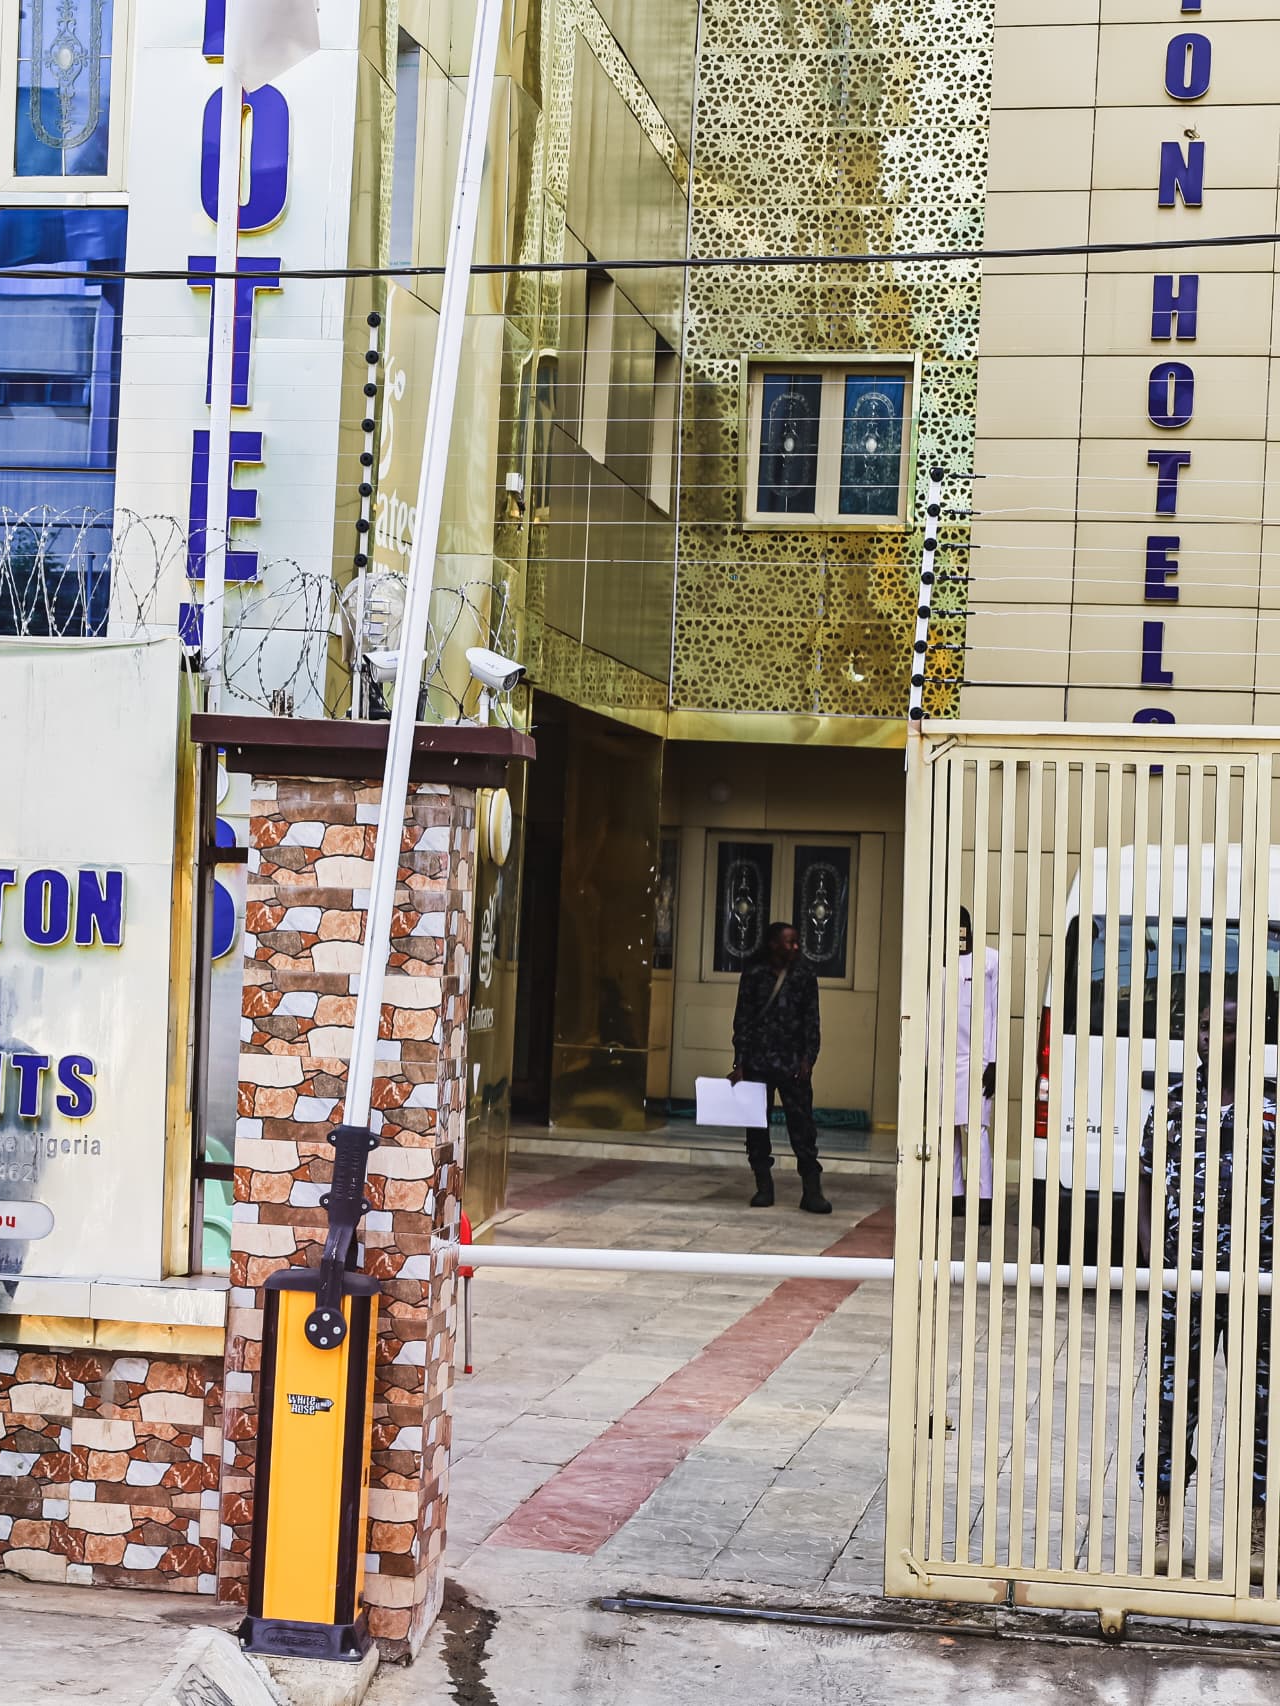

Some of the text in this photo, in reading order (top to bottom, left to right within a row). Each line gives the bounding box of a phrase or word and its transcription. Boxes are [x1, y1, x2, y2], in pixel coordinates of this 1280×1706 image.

[178, 0, 295, 650] OTE
[1131, 0, 1212, 776] ON HOTEL
